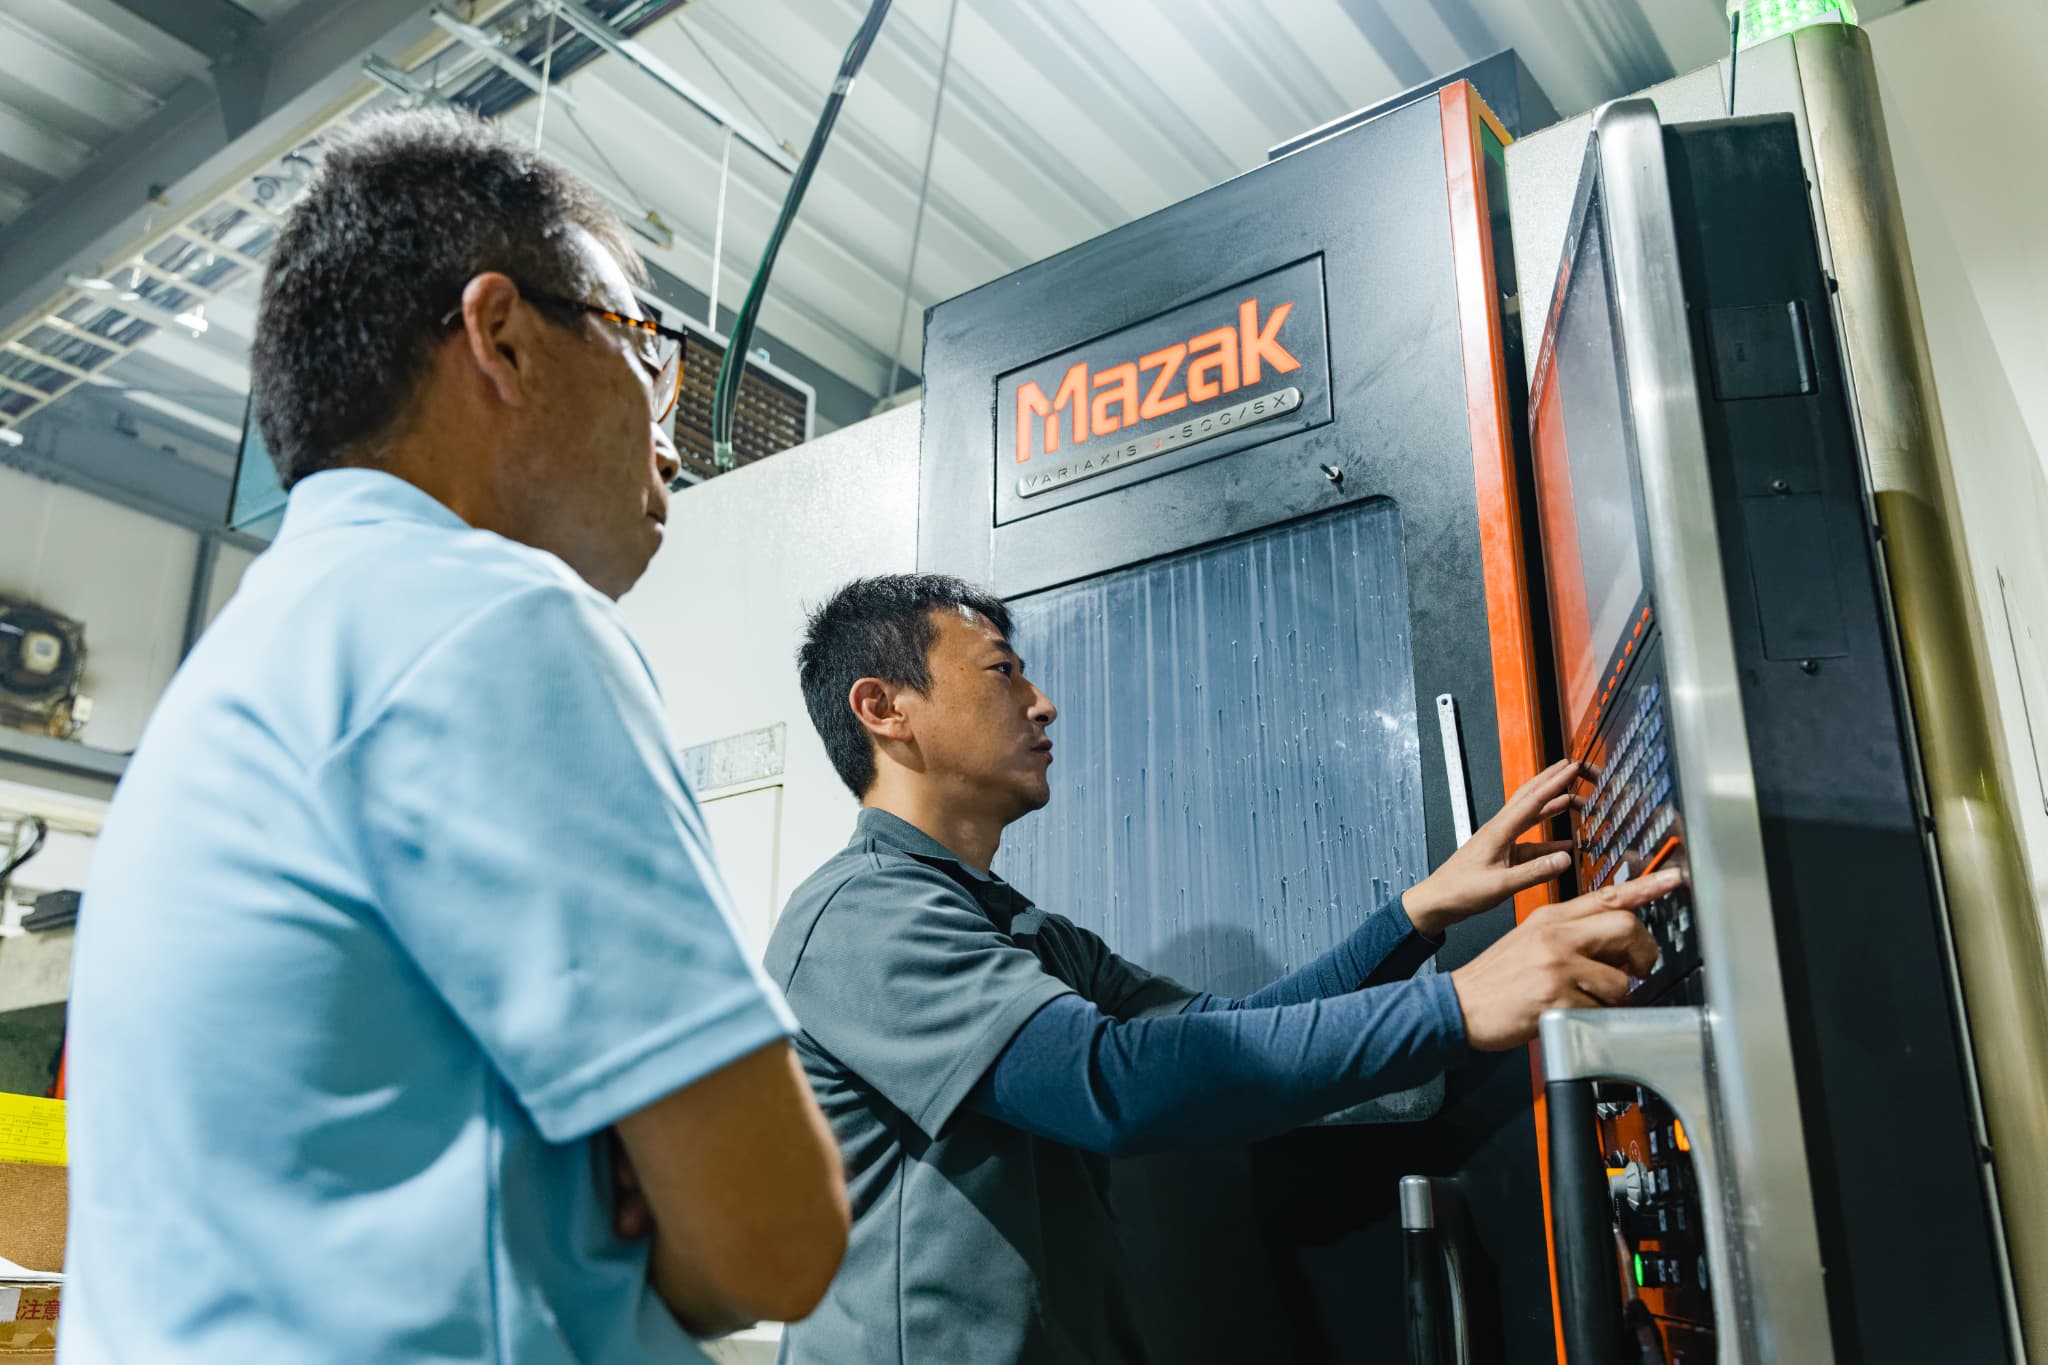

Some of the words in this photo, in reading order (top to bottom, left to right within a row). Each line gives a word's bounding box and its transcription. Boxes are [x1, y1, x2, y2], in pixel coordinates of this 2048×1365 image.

[1016, 298, 1302, 463] Mazak
[1025, 445, 1137, 488] VARIAXIS
[16, 1299, 60, 1320] 注意
